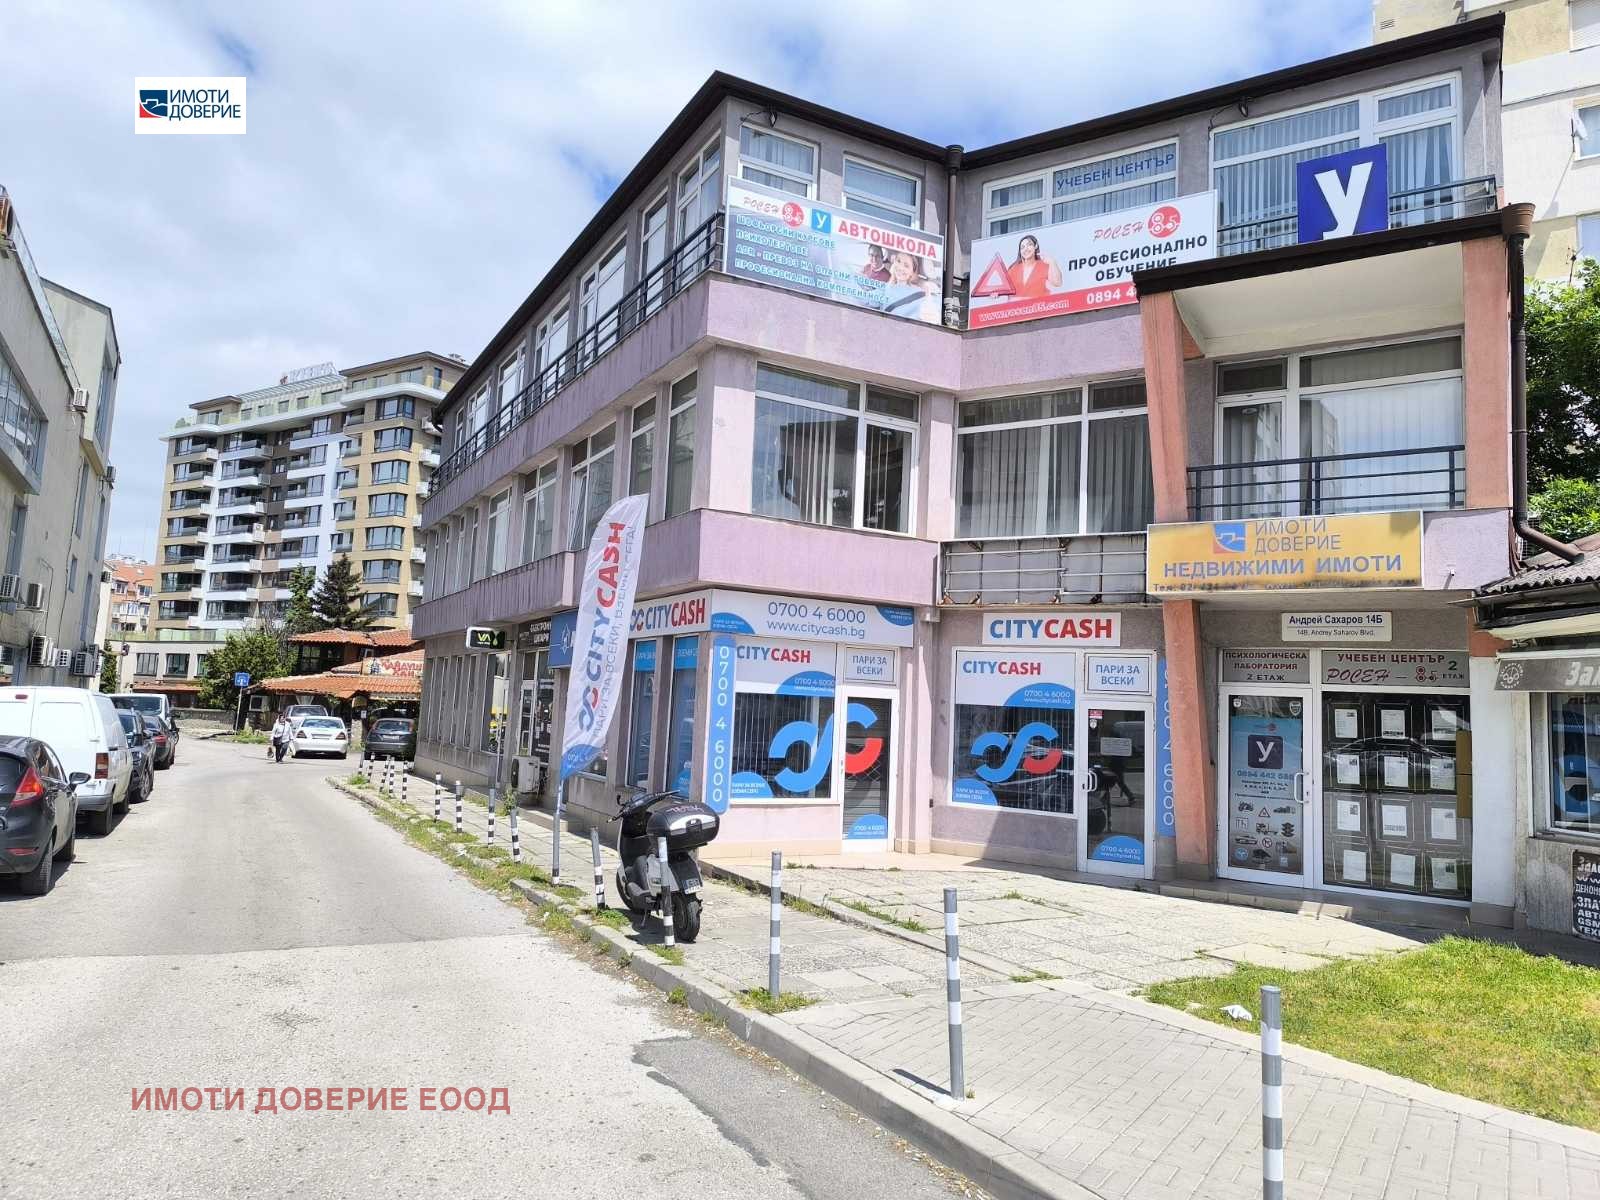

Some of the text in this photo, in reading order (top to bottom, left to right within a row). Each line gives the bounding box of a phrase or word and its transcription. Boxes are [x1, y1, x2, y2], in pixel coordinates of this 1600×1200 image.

[1057, 153, 1175, 190] УЧЕБЕН ЦЕНТЪР
[838, 220, 938, 258] АВТОШКОЛА
[1093, 221, 1144, 242] РОСЕН
[1068, 235, 1208, 271] ПРОФЕСИОНАЛНО
[1086, 289, 1121, 304] 0894
[1255, 518, 1326, 535] ИМОТИ
[1255, 534, 1342, 554] ДОВЕРИЕ
[1164, 554, 1401, 580] НЕДВИЖИМИ ИМОТИ
[645, 598, 705, 630] CITYCASH
[768, 601, 808, 618] 0700
[812, 605, 823, 620] 4
[827, 607, 866, 624] 6000
[1289, 614, 1383, 625] Андрей Сахаров 14Б
[766, 619, 866, 639] www.citycash.bg
[990, 618, 1112, 639] CITYCASH
[736, 645, 811, 664] CITYCASH
[852, 655, 888, 666] ПАРИ ЗА
[1338, 654, 1445, 664] УЧЕБЕН ЦЕНТЪР
[856, 666, 883, 676] ВСЕКИ
[963, 661, 1041, 675] CITYCASH
[1095, 664, 1140, 674] ПАРИ ЗА
[1448, 661, 1457, 671] 2
[1101, 676, 1134, 685] ВСЕКИ
[1247, 673, 1254, 681] 2
[1327, 668, 1391, 683] РОСЕН
[1024, 689, 1043, 698] 0700
[712, 646, 730, 802] 0700 4 6000
[1577, 896, 1600, 910] ЗЛА
